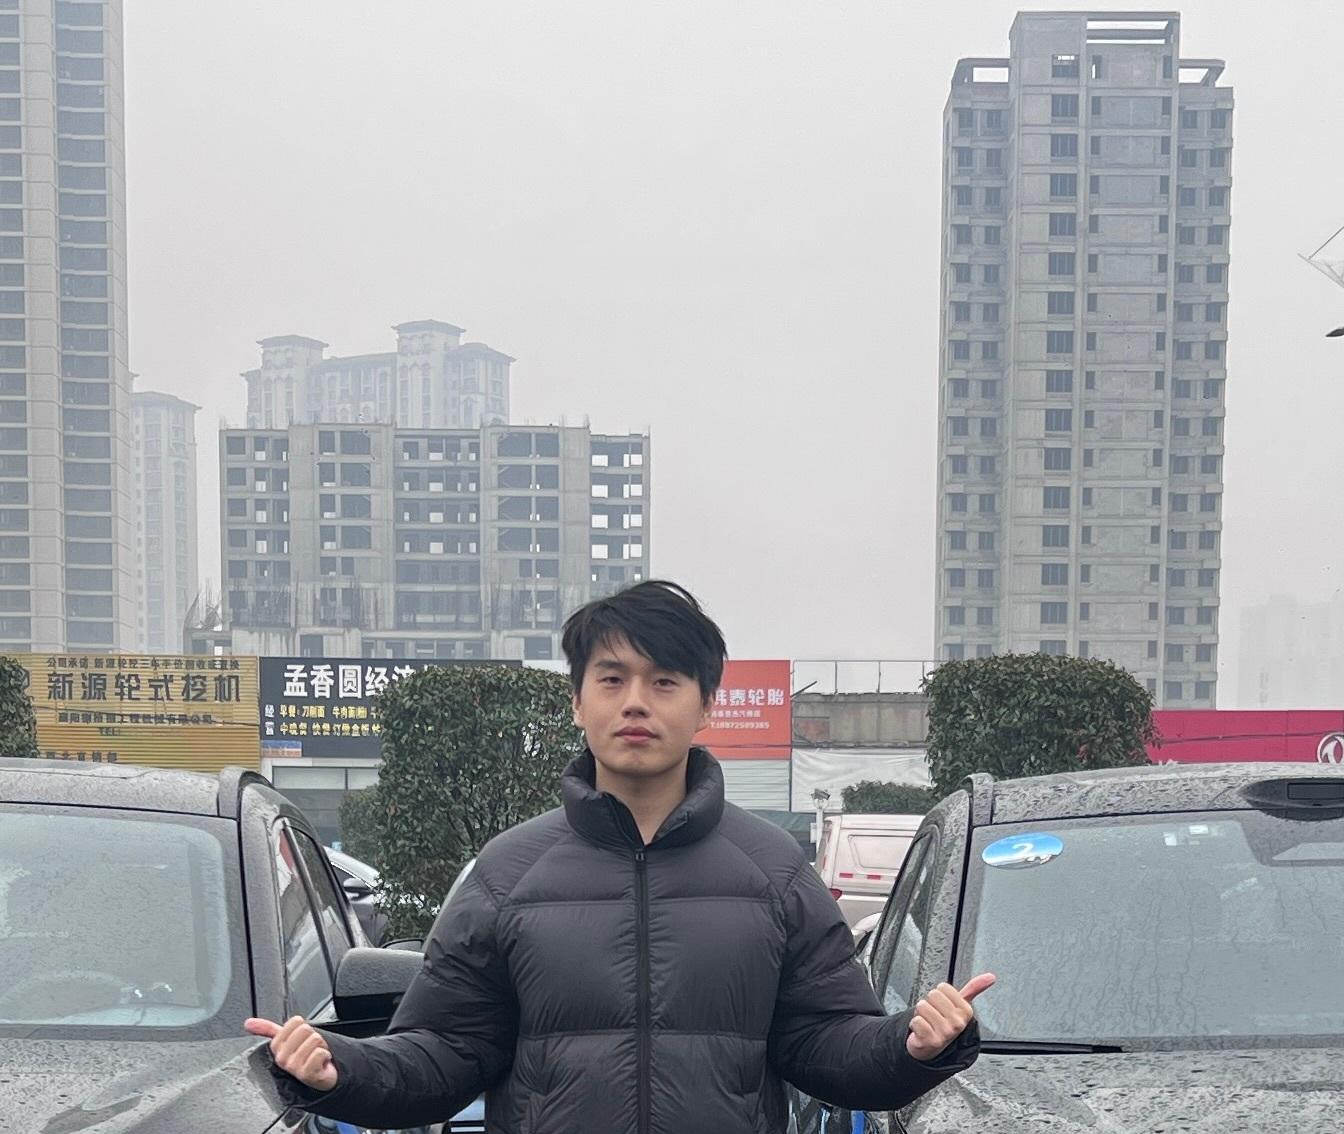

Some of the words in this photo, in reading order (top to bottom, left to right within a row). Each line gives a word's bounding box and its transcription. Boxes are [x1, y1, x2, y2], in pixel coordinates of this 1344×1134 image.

[47, 672, 241, 702] 新源轮式挖机
